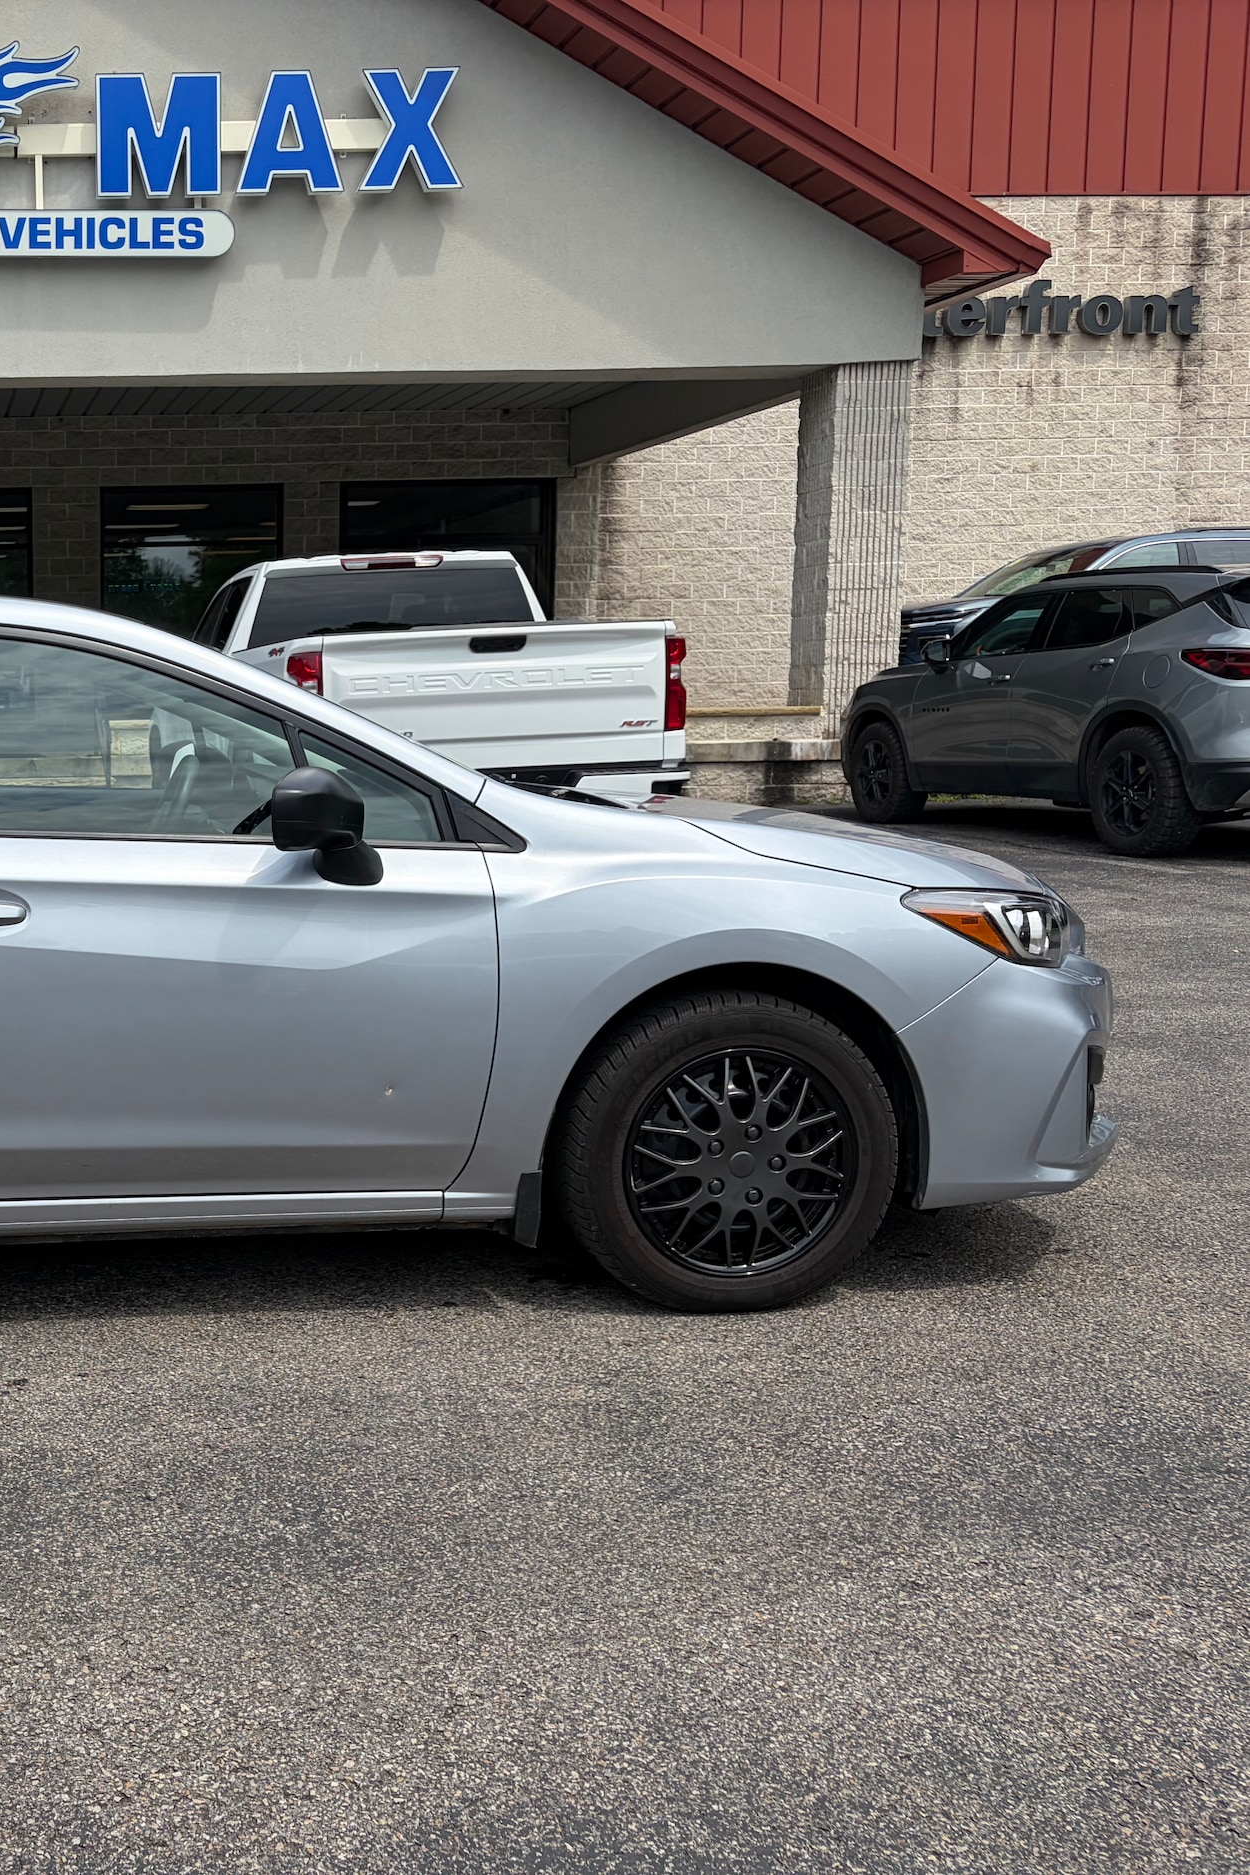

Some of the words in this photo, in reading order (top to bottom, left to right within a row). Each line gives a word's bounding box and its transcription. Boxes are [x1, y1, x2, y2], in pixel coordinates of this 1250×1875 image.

[95, 65, 464, 199] MAX
[349, 665, 645, 695] CHEVROLET
[618, 719, 658, 728] RST
